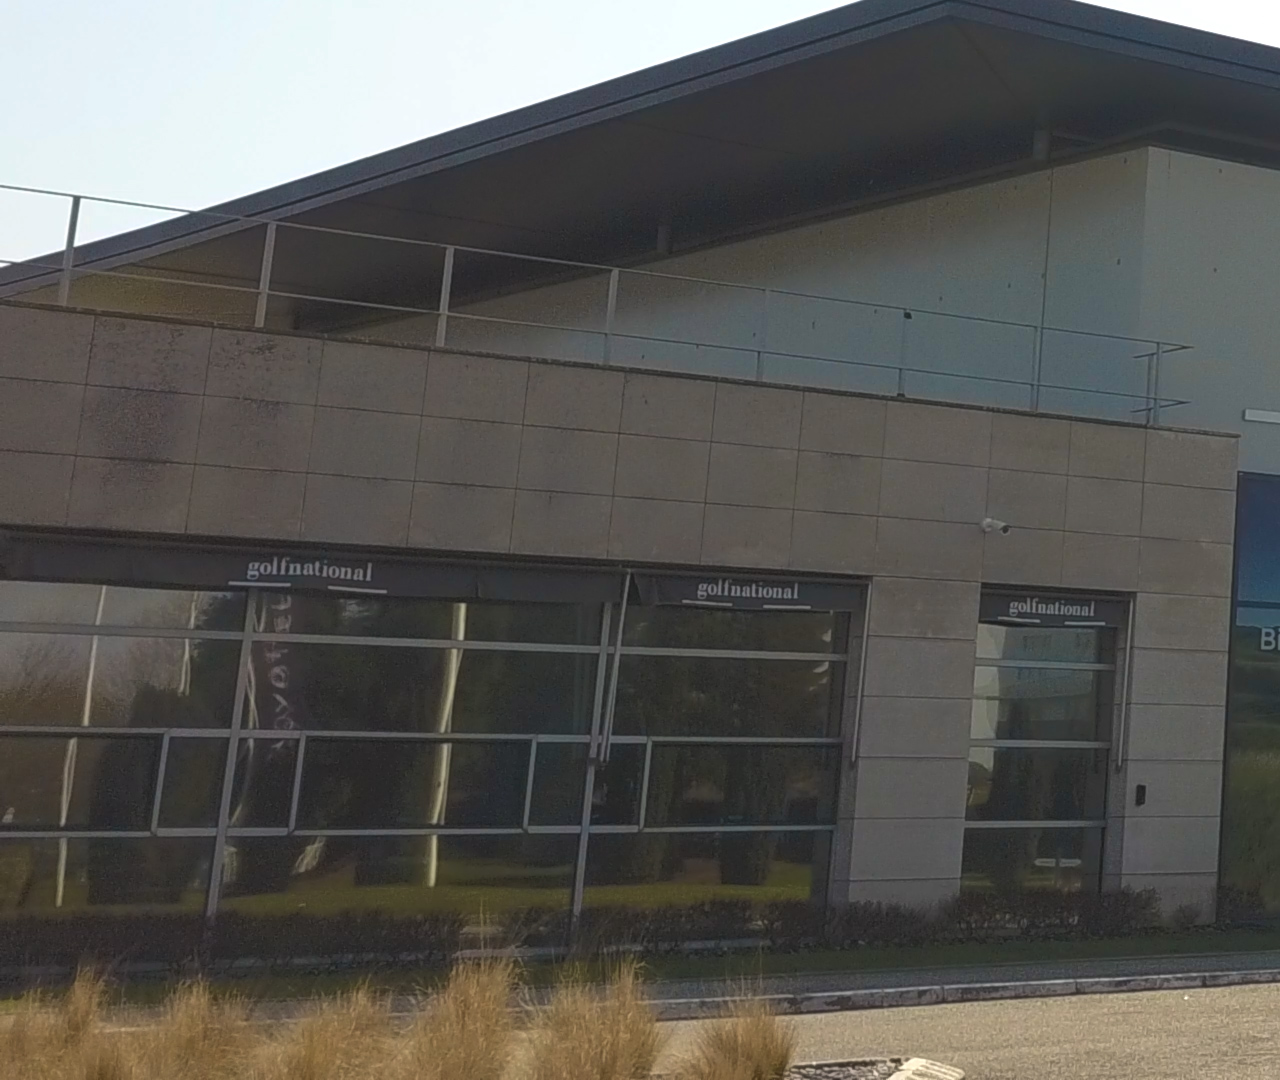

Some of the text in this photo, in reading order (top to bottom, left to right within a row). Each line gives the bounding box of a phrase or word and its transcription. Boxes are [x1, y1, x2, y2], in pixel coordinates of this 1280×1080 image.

[246, 557, 373, 581] golfnational
[697, 580, 799, 600] golfnational
[1008, 598, 1094, 617] golfnational
